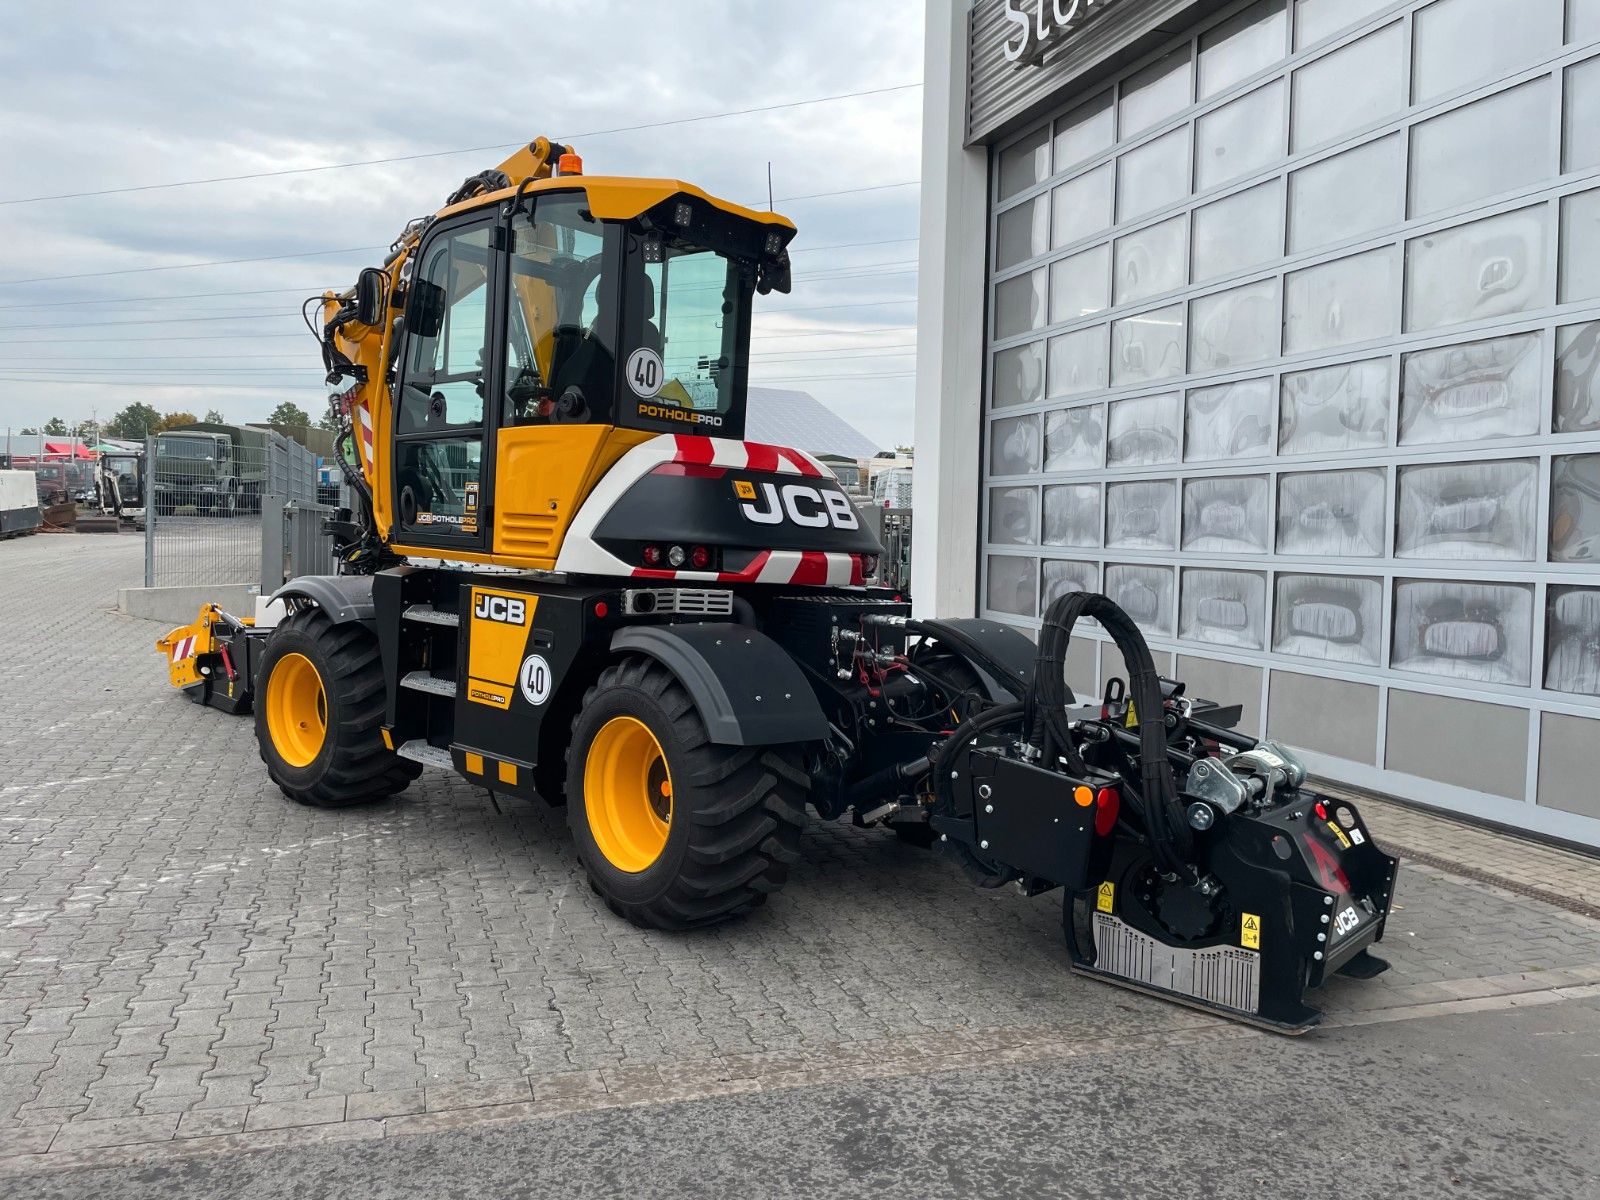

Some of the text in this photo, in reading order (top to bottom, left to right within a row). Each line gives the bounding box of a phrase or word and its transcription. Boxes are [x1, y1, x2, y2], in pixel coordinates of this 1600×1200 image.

[634, 357, 657, 388] 40
[638, 403, 723, 427] POTHOLEPRO
[741, 482, 859, 530] JCB
[475, 595, 526, 624] JCB
[527, 664, 544, 695] 40
[1335, 906, 1360, 936] JCB
